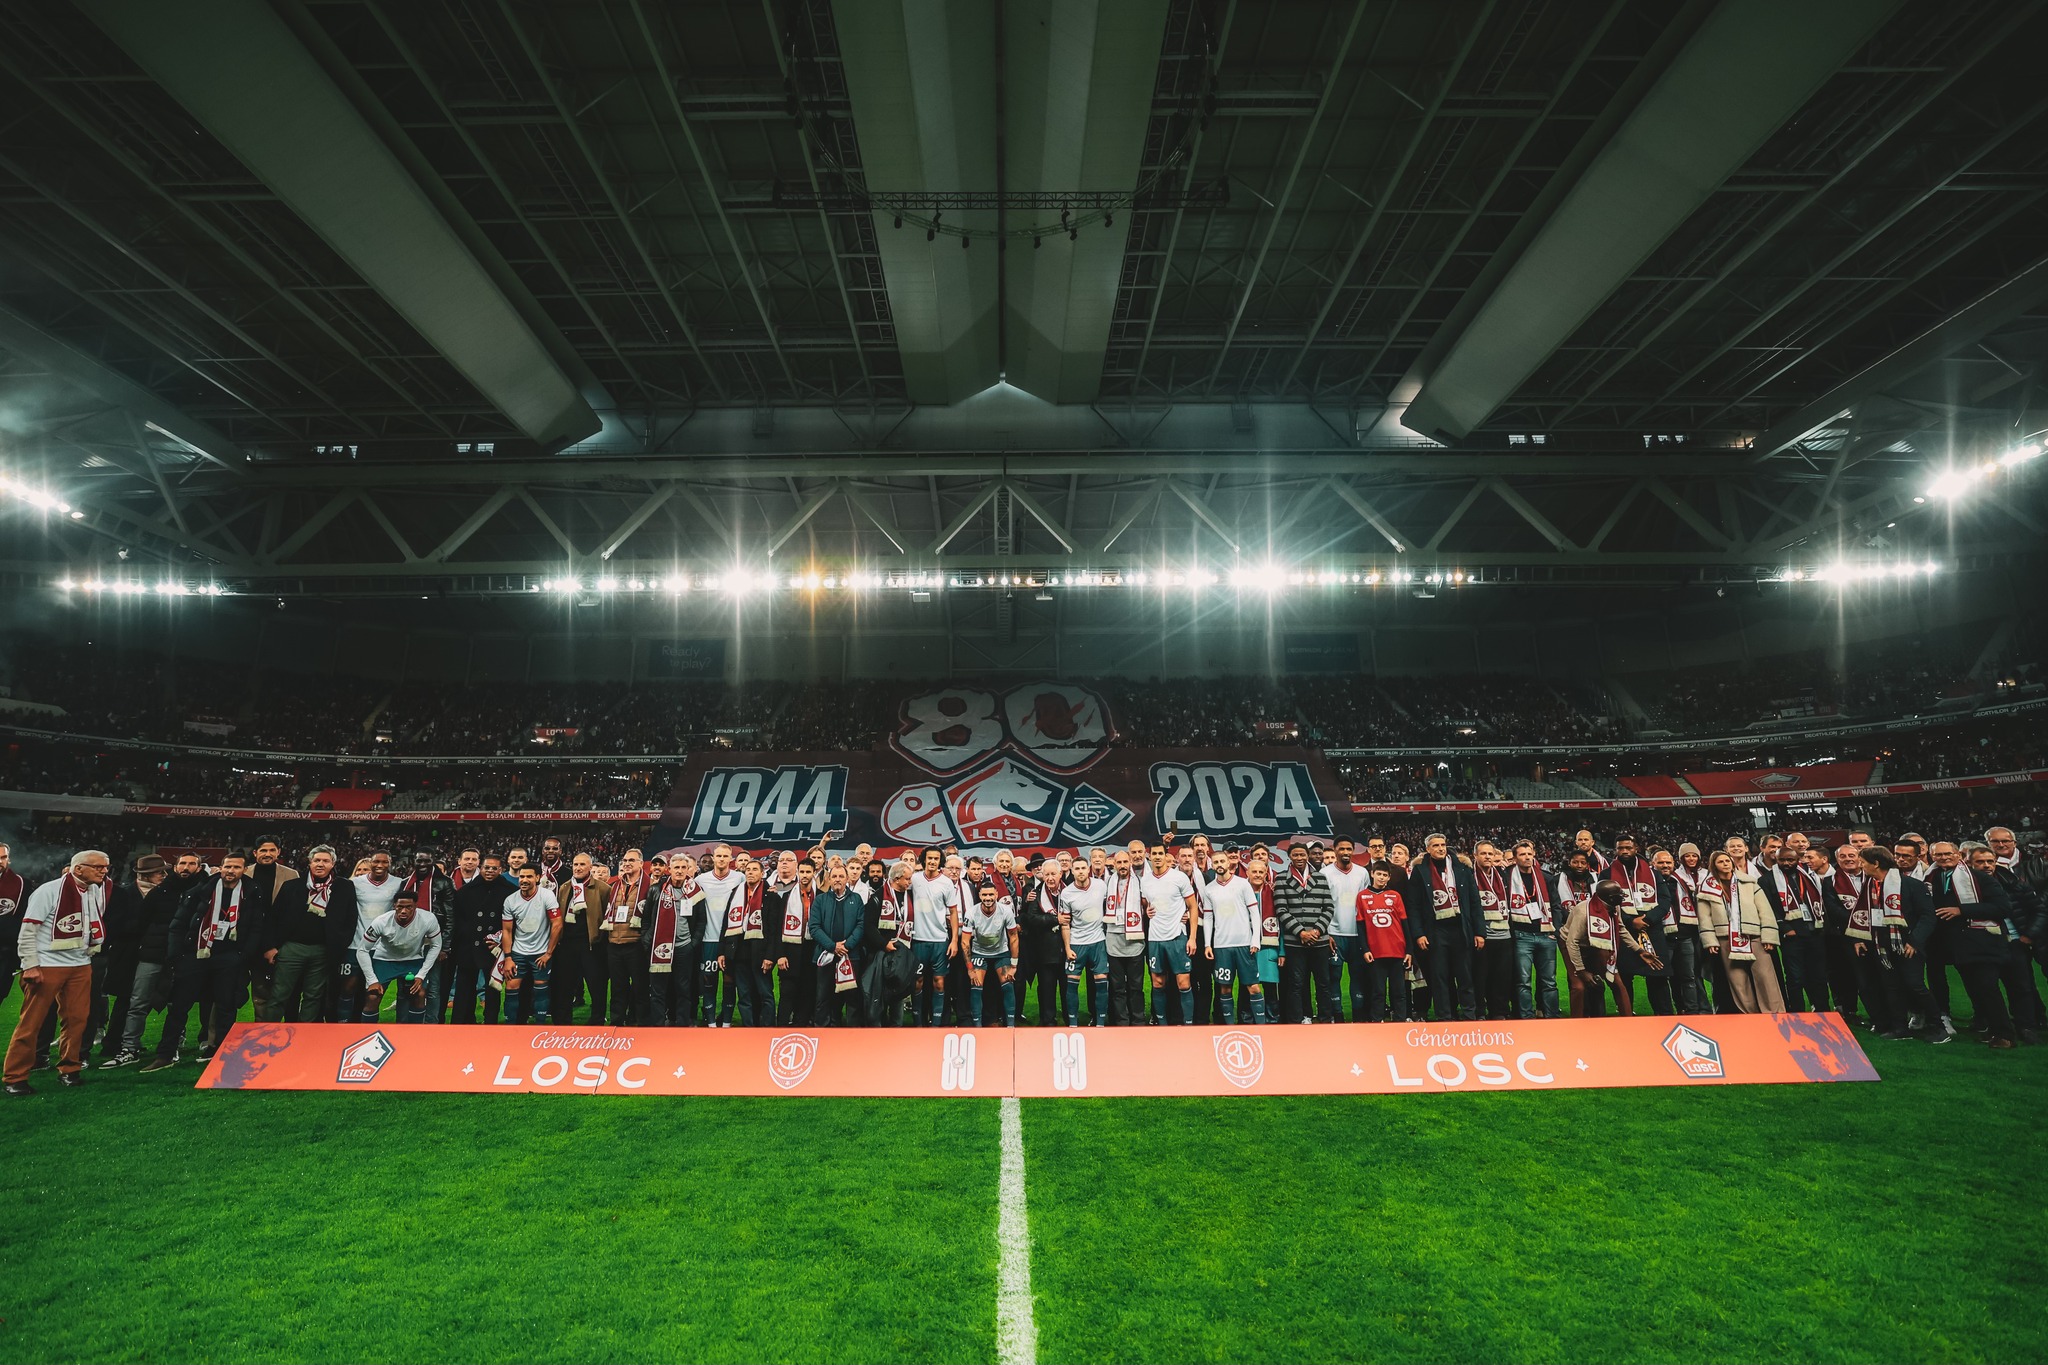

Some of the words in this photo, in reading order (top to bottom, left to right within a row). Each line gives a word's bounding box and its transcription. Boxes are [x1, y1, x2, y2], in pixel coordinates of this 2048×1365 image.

[899, 683, 1106, 769] 80
[1994, 774, 2033, 784] WINAMAX
[1851, 787, 1889, 796] WINAMAX
[1921, 781, 1960, 791] WINAMAX
[1157, 766, 1313, 829] 2024
[1671, 798, 1702, 806] WINAMAX
[1733, 795, 1767, 803] WINAMAX
[1788, 792, 1825, 800] WINAMAX
[694, 771, 833, 835] 1944
[1612, 800, 1638, 808] WINAMAX
[972, 828, 1040, 841] LOSC
[340, 963, 352, 976] 18
[704, 960, 718, 972] 20
[1218, 967, 1231, 981] 23
[531, 1031, 635, 1050] Générations
[1406, 1028, 1515, 1047] Générations
[343, 1068, 371, 1078] LOSC
[492, 1055, 652, 1089] LOSC
[1386, 1051, 1555, 1087] LOSC
[1686, 1063, 1717, 1073] LOSC
